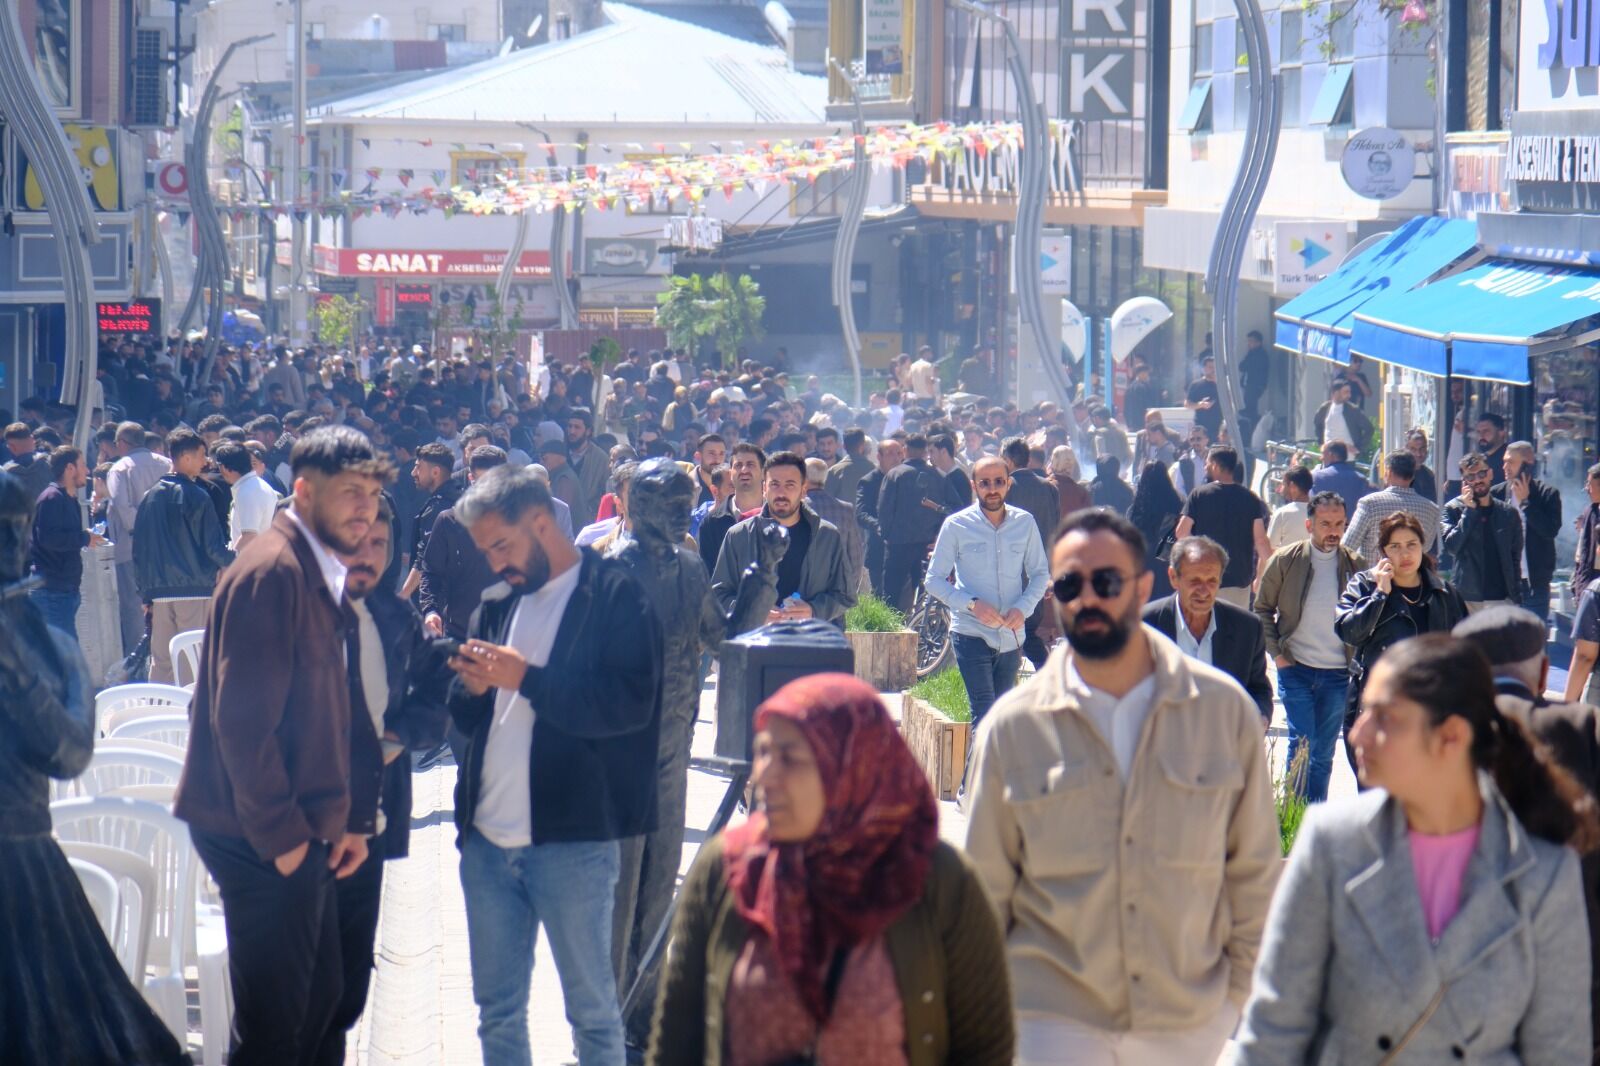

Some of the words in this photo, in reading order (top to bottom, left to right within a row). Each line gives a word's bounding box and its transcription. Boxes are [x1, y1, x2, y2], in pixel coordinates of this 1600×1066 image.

[1505, 136, 1560, 181] AKSESUAR
[1562, 136, 1571, 182] &
[356, 253, 443, 273] SANAT
